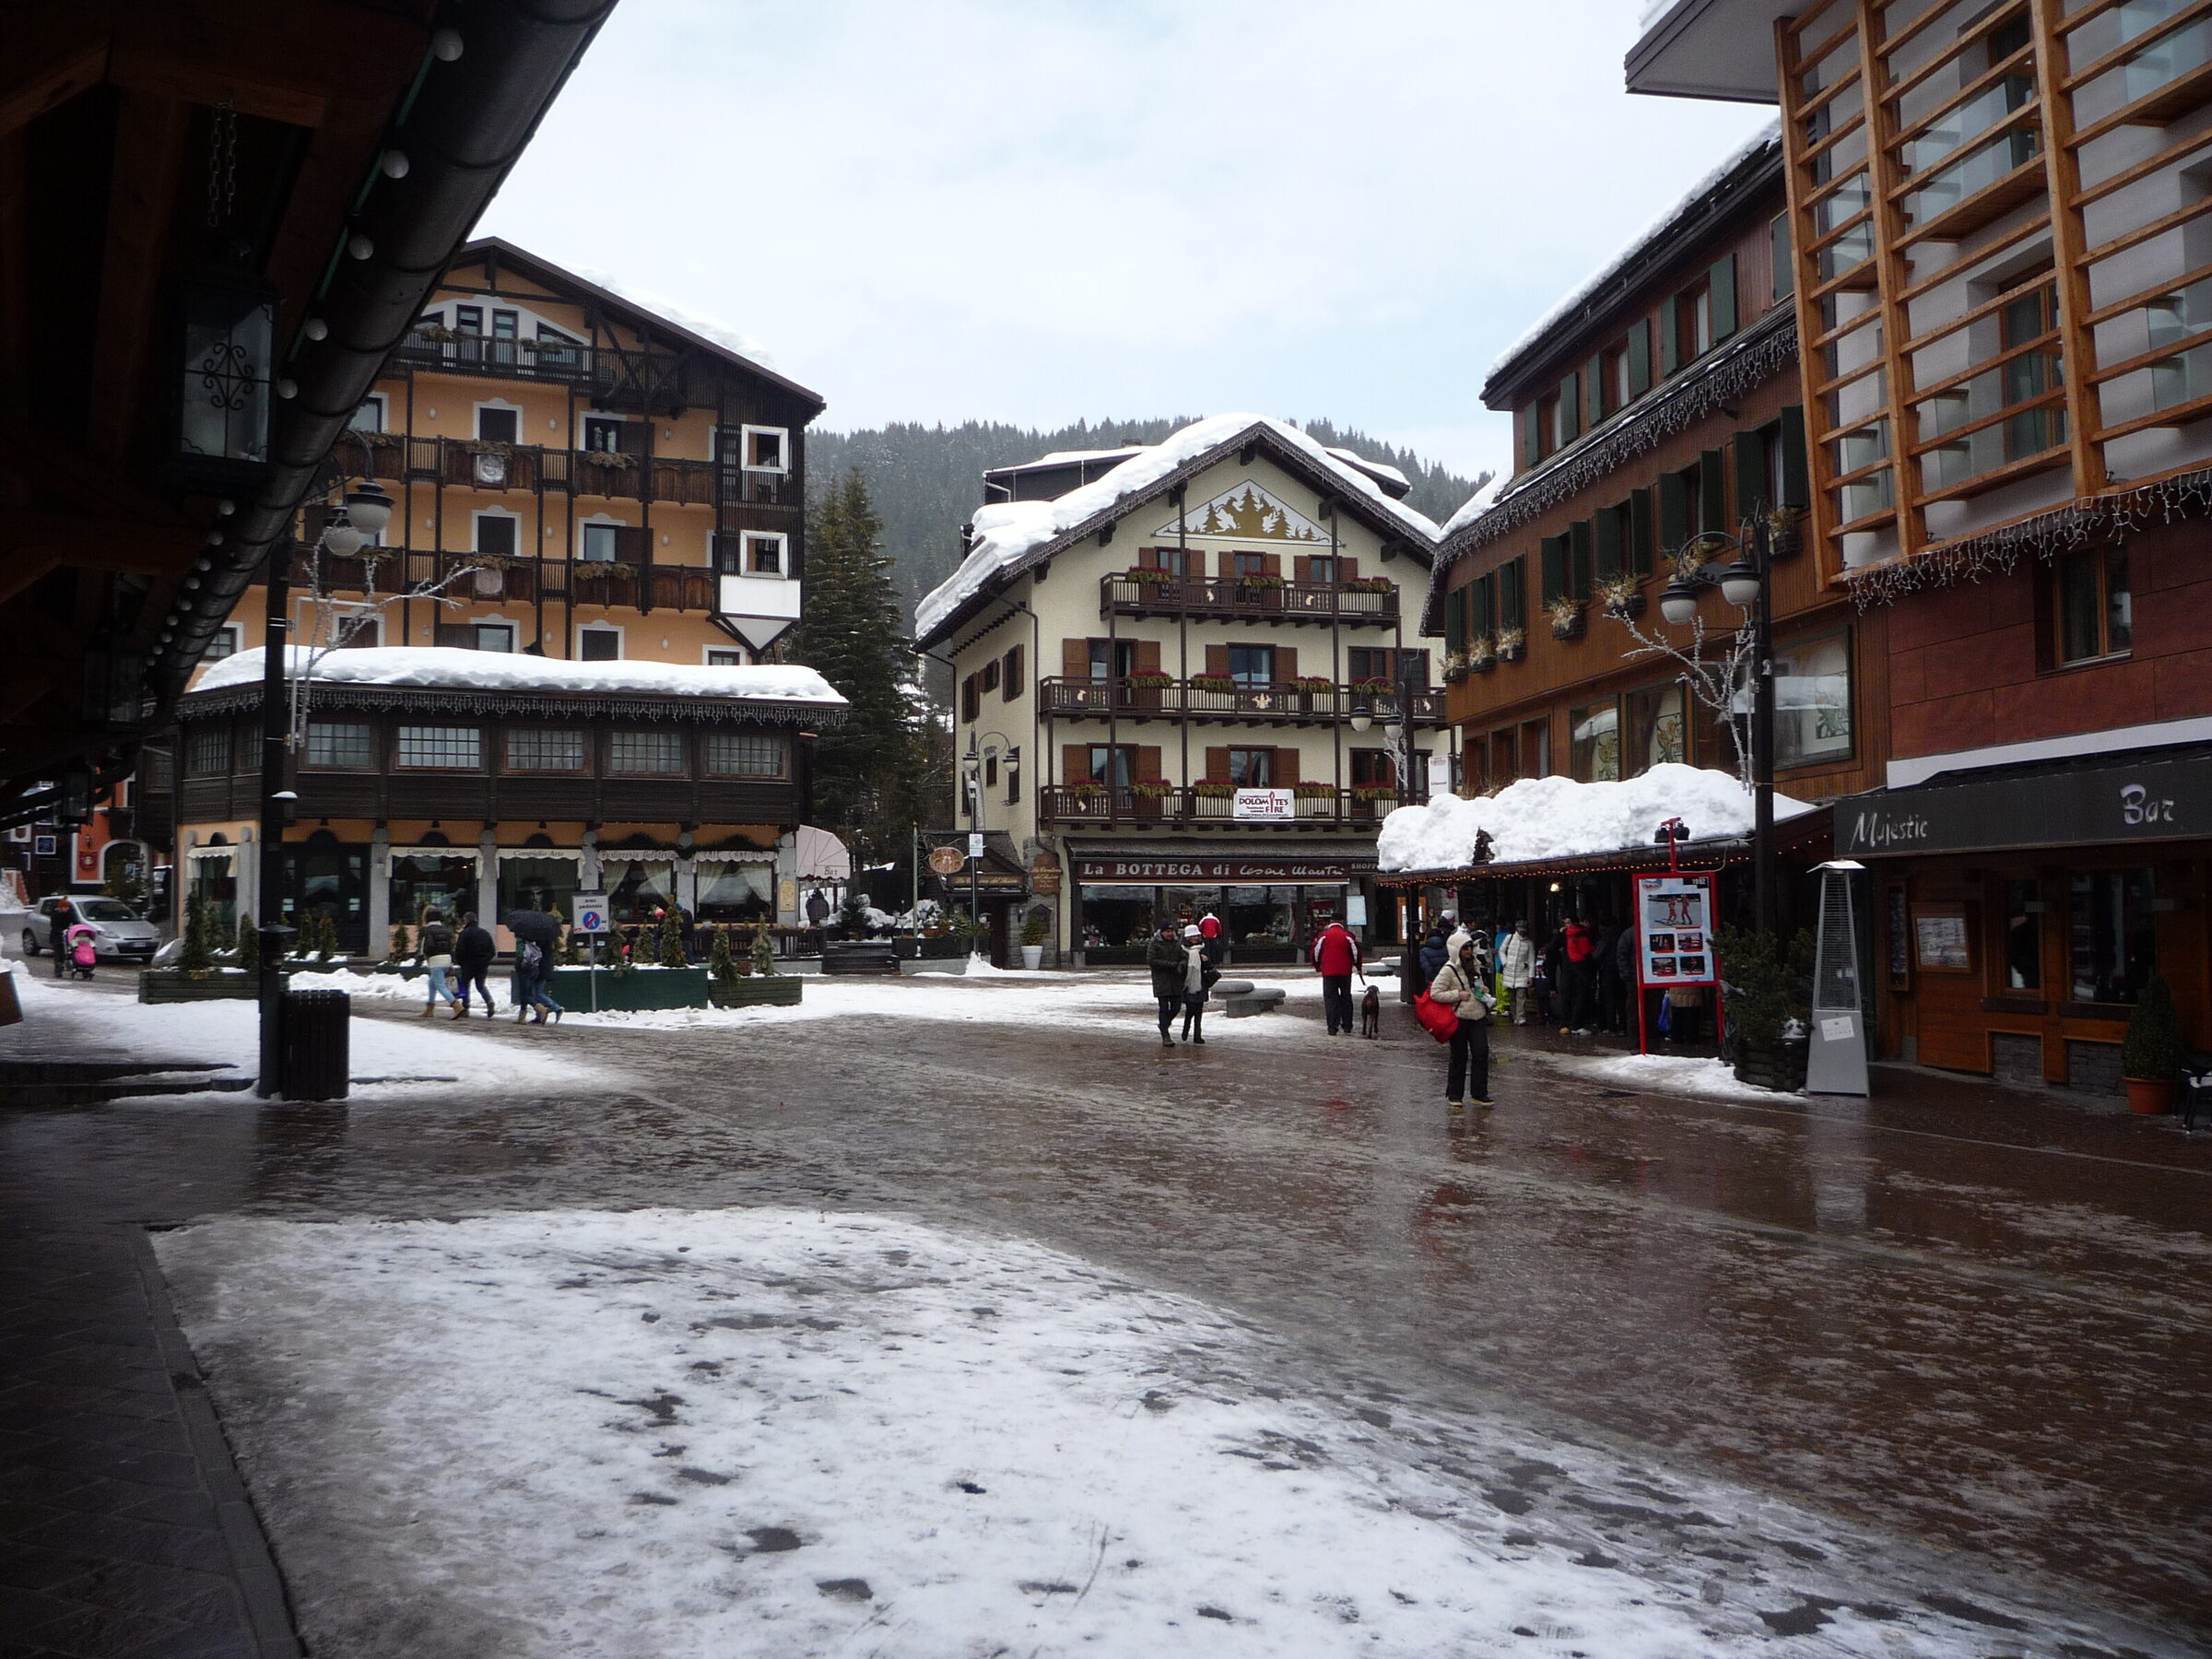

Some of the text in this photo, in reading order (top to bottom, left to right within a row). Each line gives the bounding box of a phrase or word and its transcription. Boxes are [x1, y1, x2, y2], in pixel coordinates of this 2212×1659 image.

[2119, 782, 2175, 825] Bar
[1849, 811, 1928, 851] Majestic
[1083, 863, 1104, 876] La
[1115, 863, 1204, 876] BOTTEGA
[1212, 864, 1230, 876] di
[1350, 862, 1379, 870] SHOPP
